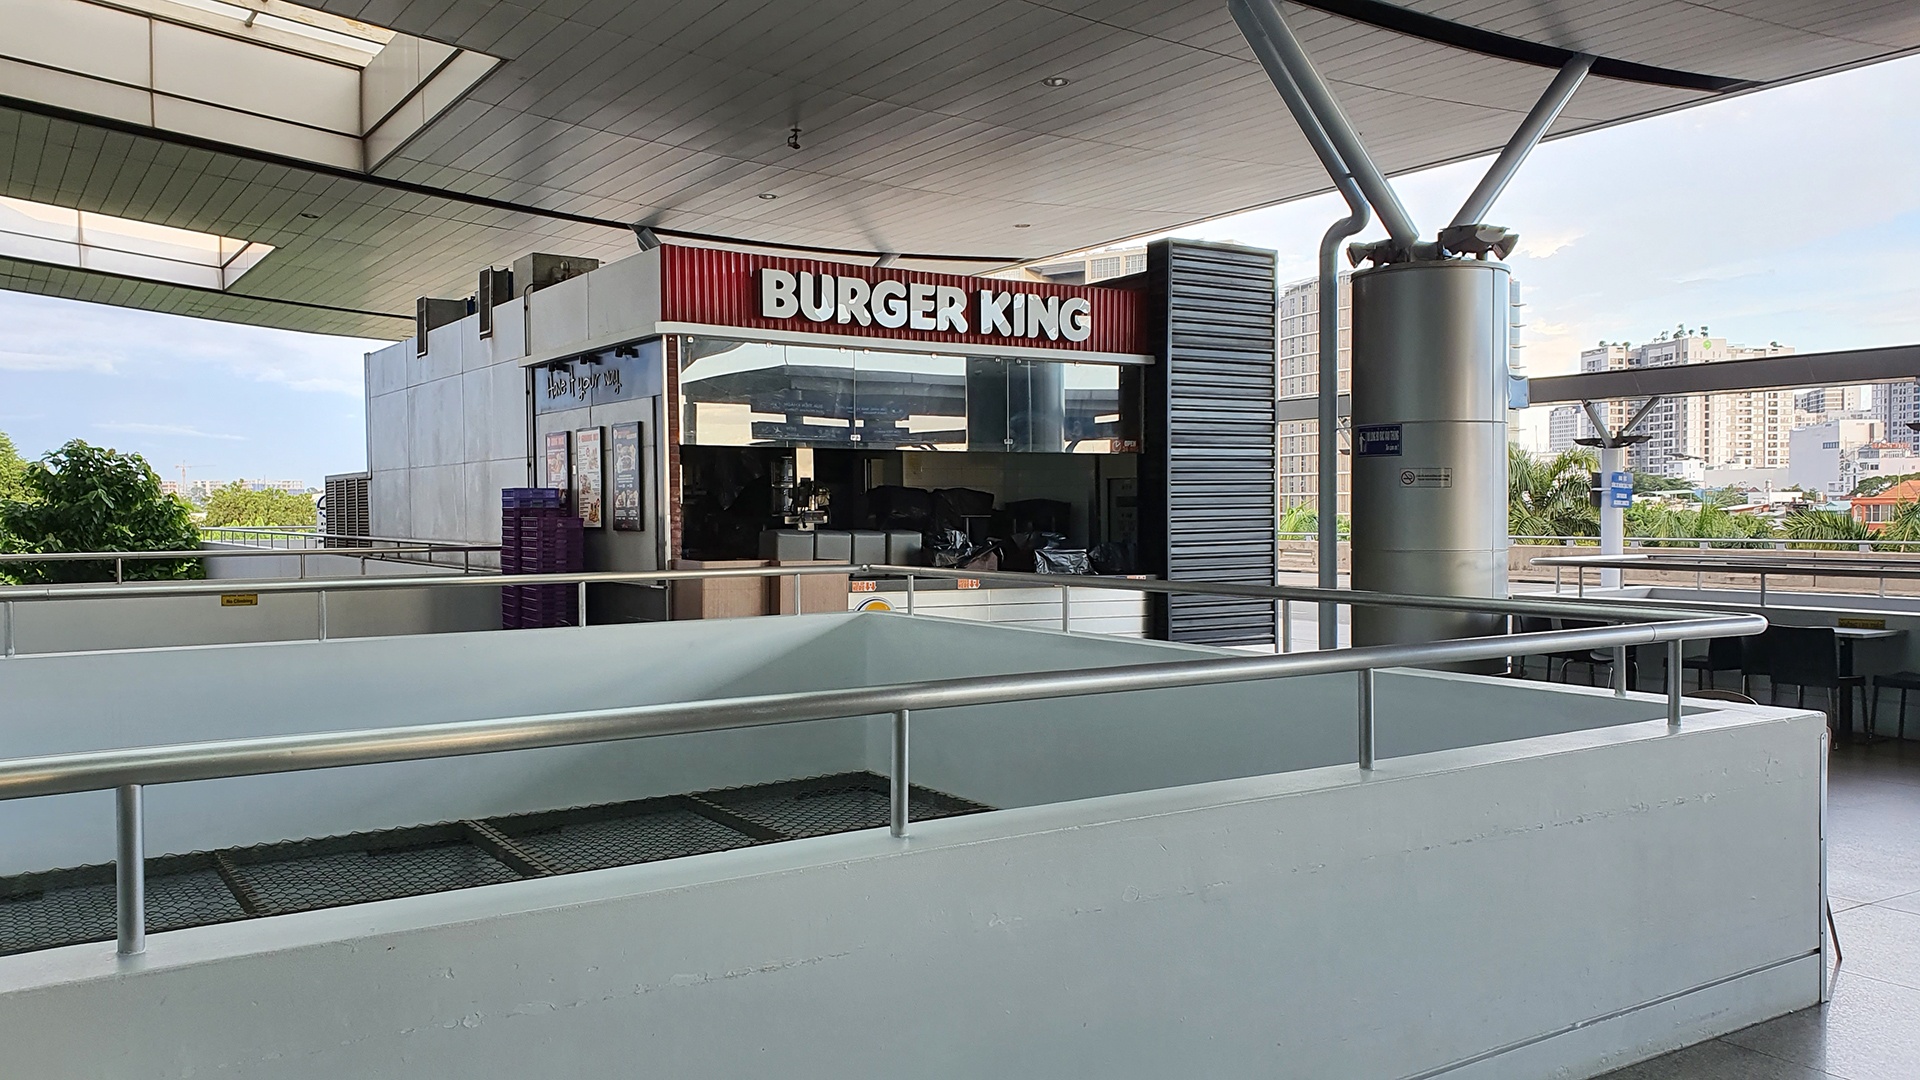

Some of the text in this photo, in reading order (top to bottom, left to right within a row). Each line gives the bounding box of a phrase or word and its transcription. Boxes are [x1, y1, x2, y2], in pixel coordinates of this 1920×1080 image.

[761, 267, 1092, 342] BURGER KING
[547, 370, 567, 400] Have
[568, 364, 576, 398] it
[578, 373, 600, 402] your
